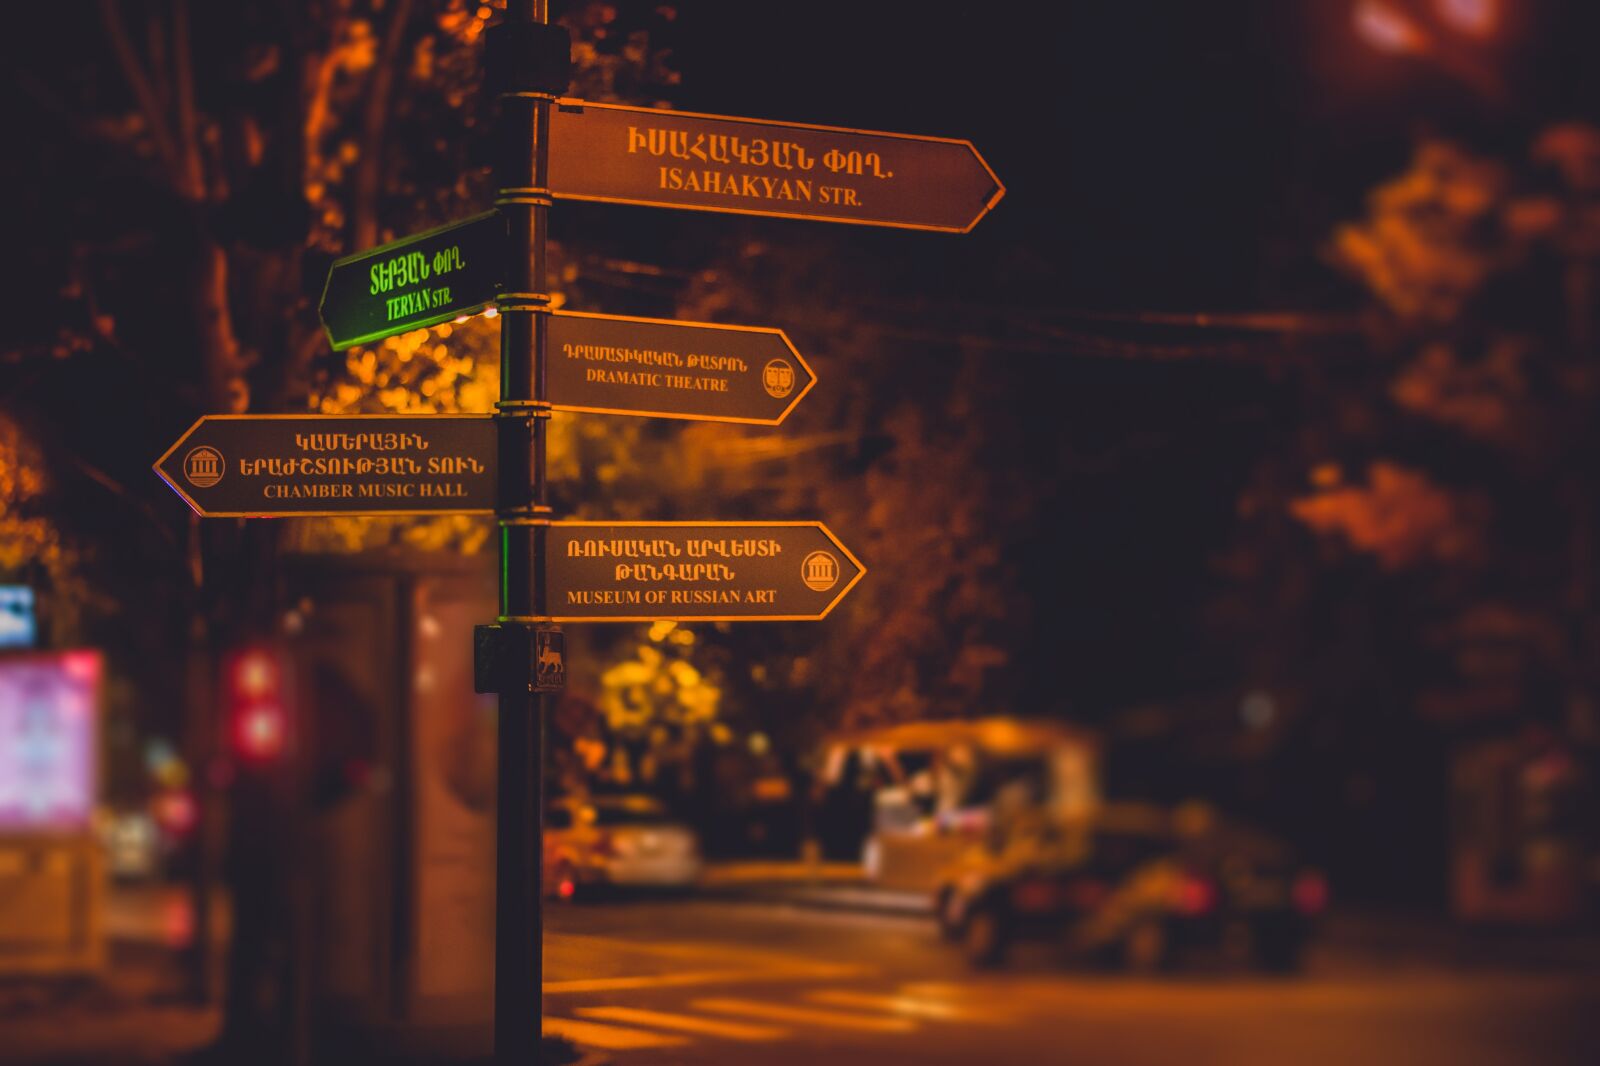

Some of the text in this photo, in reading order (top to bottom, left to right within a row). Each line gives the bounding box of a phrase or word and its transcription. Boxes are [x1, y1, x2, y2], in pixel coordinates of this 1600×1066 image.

[627, 127, 893, 178] ԻՍԱՀԱԿՅԱՆ ՓՈՂ.
[660, 167, 861, 206] ISAHAKYAN STR.
[370, 245, 466, 296] ՏԵՐՅԱՆ ՓՈՂ.
[386, 286, 454, 321] TERYAN STR.
[563, 343, 748, 372] ԴՐԱՄԱՏԻԿԱԿԱՆ ԹԱՏՐՈՆ
[587, 369, 728, 391] DRAMATIC THEATRE
[296, 433, 428, 451] ԿԱՄԵՐԱՅԻՆ
[241, 457, 484, 476] ԵՐԱԺՇՏՈՒԹՅԱՆ ՏՈՒՆ
[264, 484, 467, 497] CHAMBER MUSIC HALL
[568, 540, 781, 557] ՌՈՒՍԱԿԱՆ ԱՐՎԵՍՏԻ
[616, 564, 734, 581] ԹԱՆԳԱՐԱՆ
[568, 590, 776, 604] MUSEUM OF RUSSIAN ART
